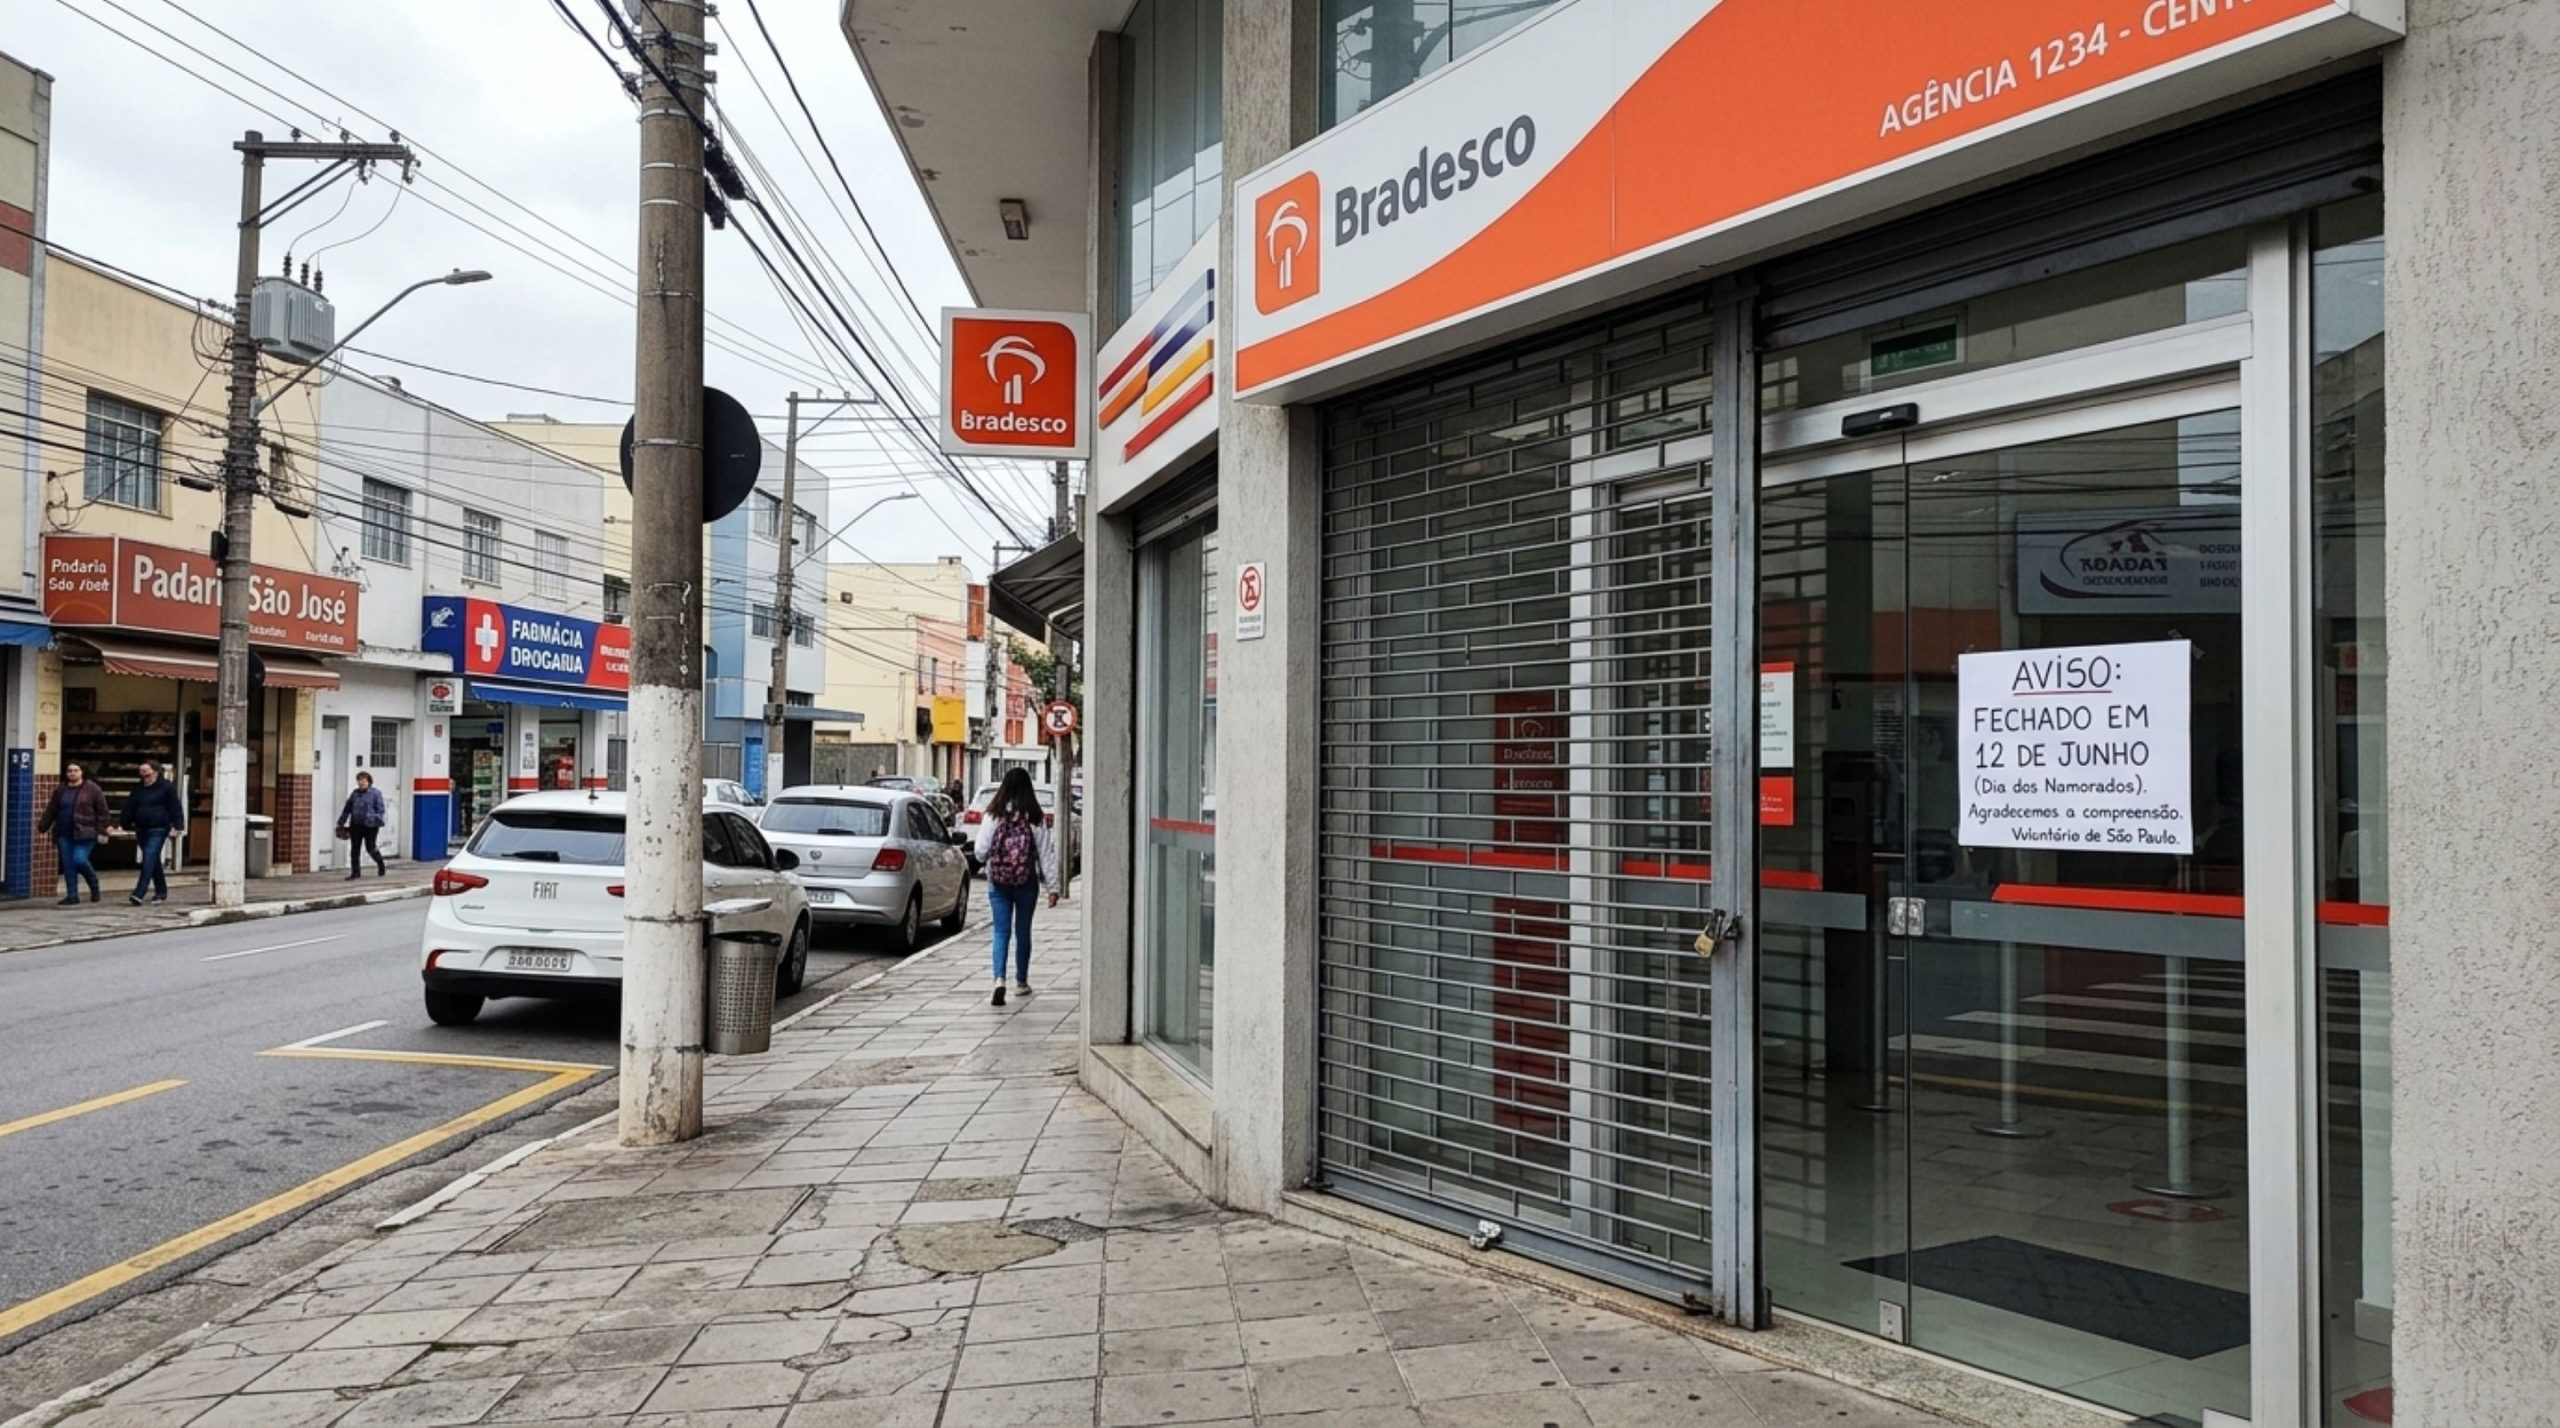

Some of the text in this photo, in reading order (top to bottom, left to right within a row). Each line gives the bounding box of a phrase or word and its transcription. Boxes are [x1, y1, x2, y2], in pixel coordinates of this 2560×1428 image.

[1879, 60, 2017, 137] AGÊNCIA
[2029, 22, 2109, 80] 1234
[1335, 114, 1536, 247] Bradesco
[960, 409, 1068, 433] Bradesco
[133, 554, 346, 625] Padari São José
[2012, 654, 2122, 690] AVISO:
[1974, 704, 2149, 732] FECHADO EM
[1976, 740, 2149, 769] 12 DE JUNHO
[1974, 774, 2147, 796] (Dia dos Namorados).
[1968, 803, 2183, 824] Agradecemos a compreensão.
[2085, 828, 2101, 843] de
[2107, 827, 2133, 843] São
[2138, 828, 2180, 845] Paulo.
[533, 881, 559, 900] FIAT
